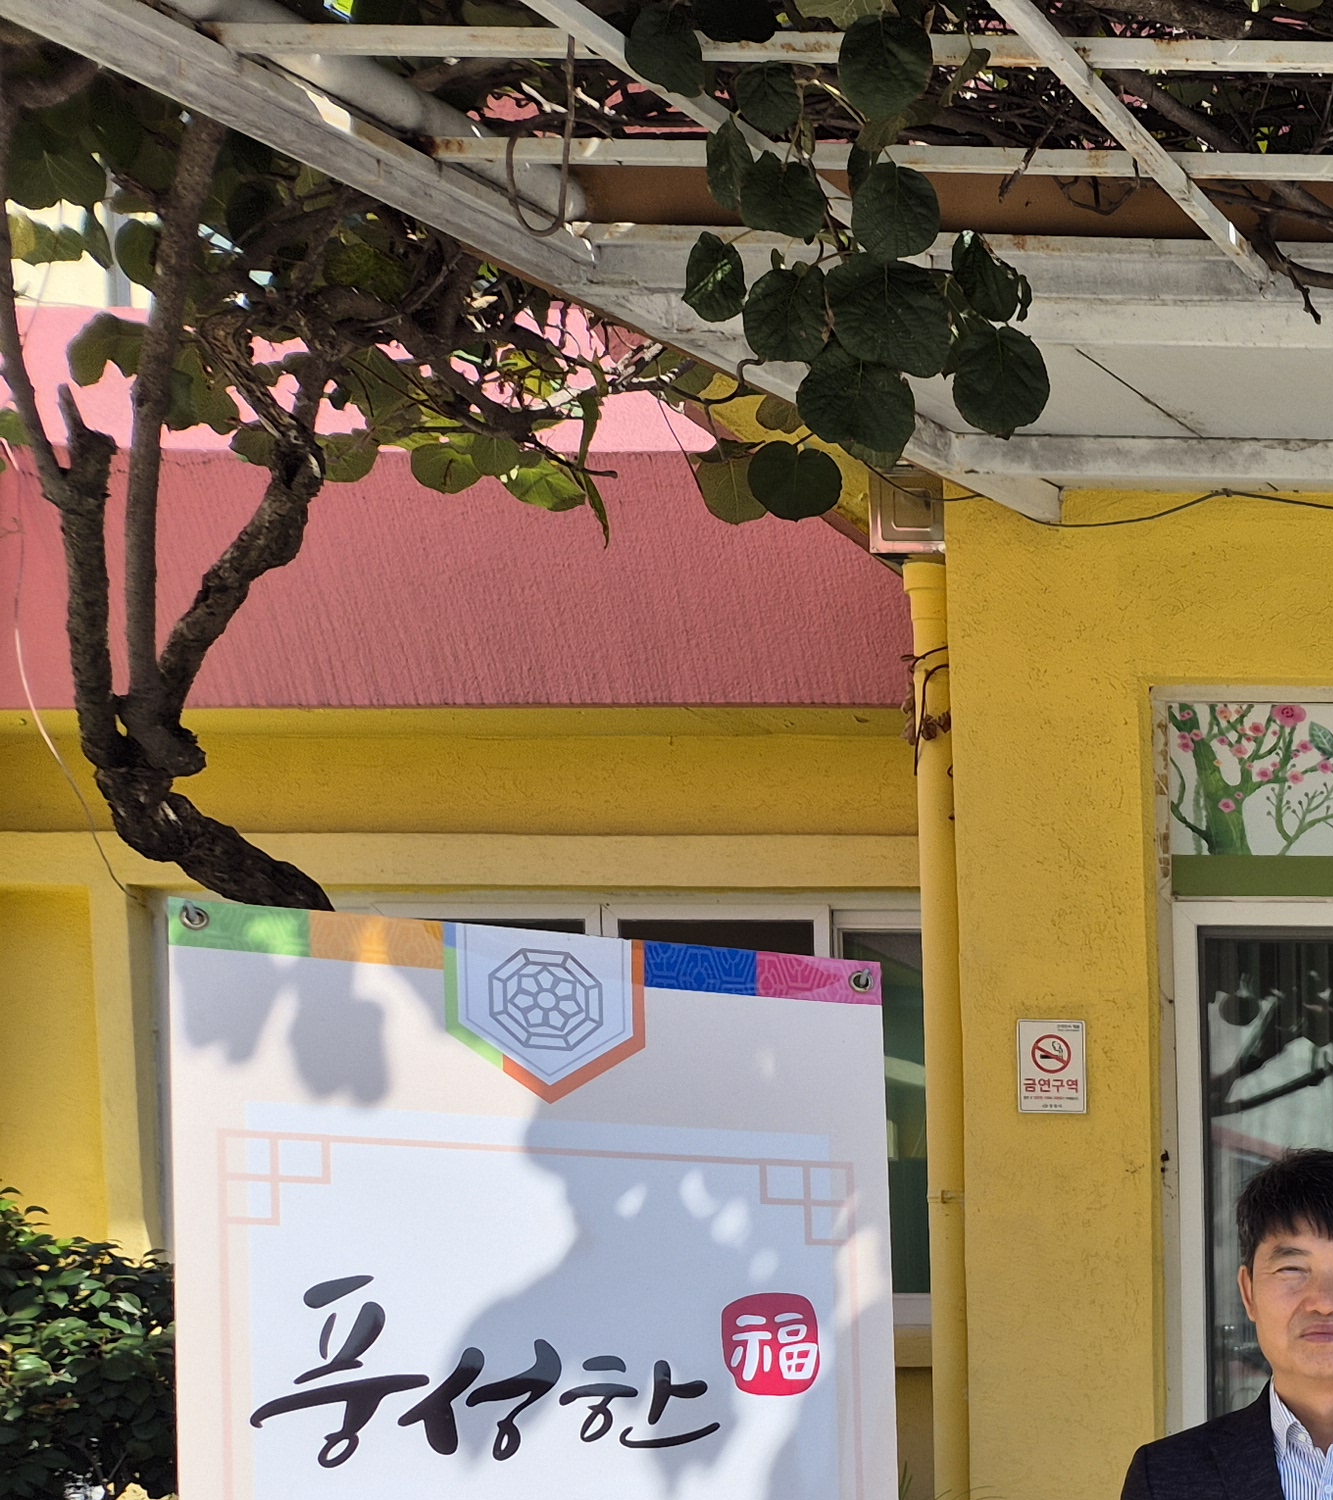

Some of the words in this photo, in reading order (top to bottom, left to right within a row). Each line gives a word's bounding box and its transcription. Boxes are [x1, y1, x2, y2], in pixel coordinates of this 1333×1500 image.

[1023, 1078, 1079, 1093] 금연구역
[250, 1275, 720, 1468] 풍성한
[731, 1311, 818, 1383] 福
